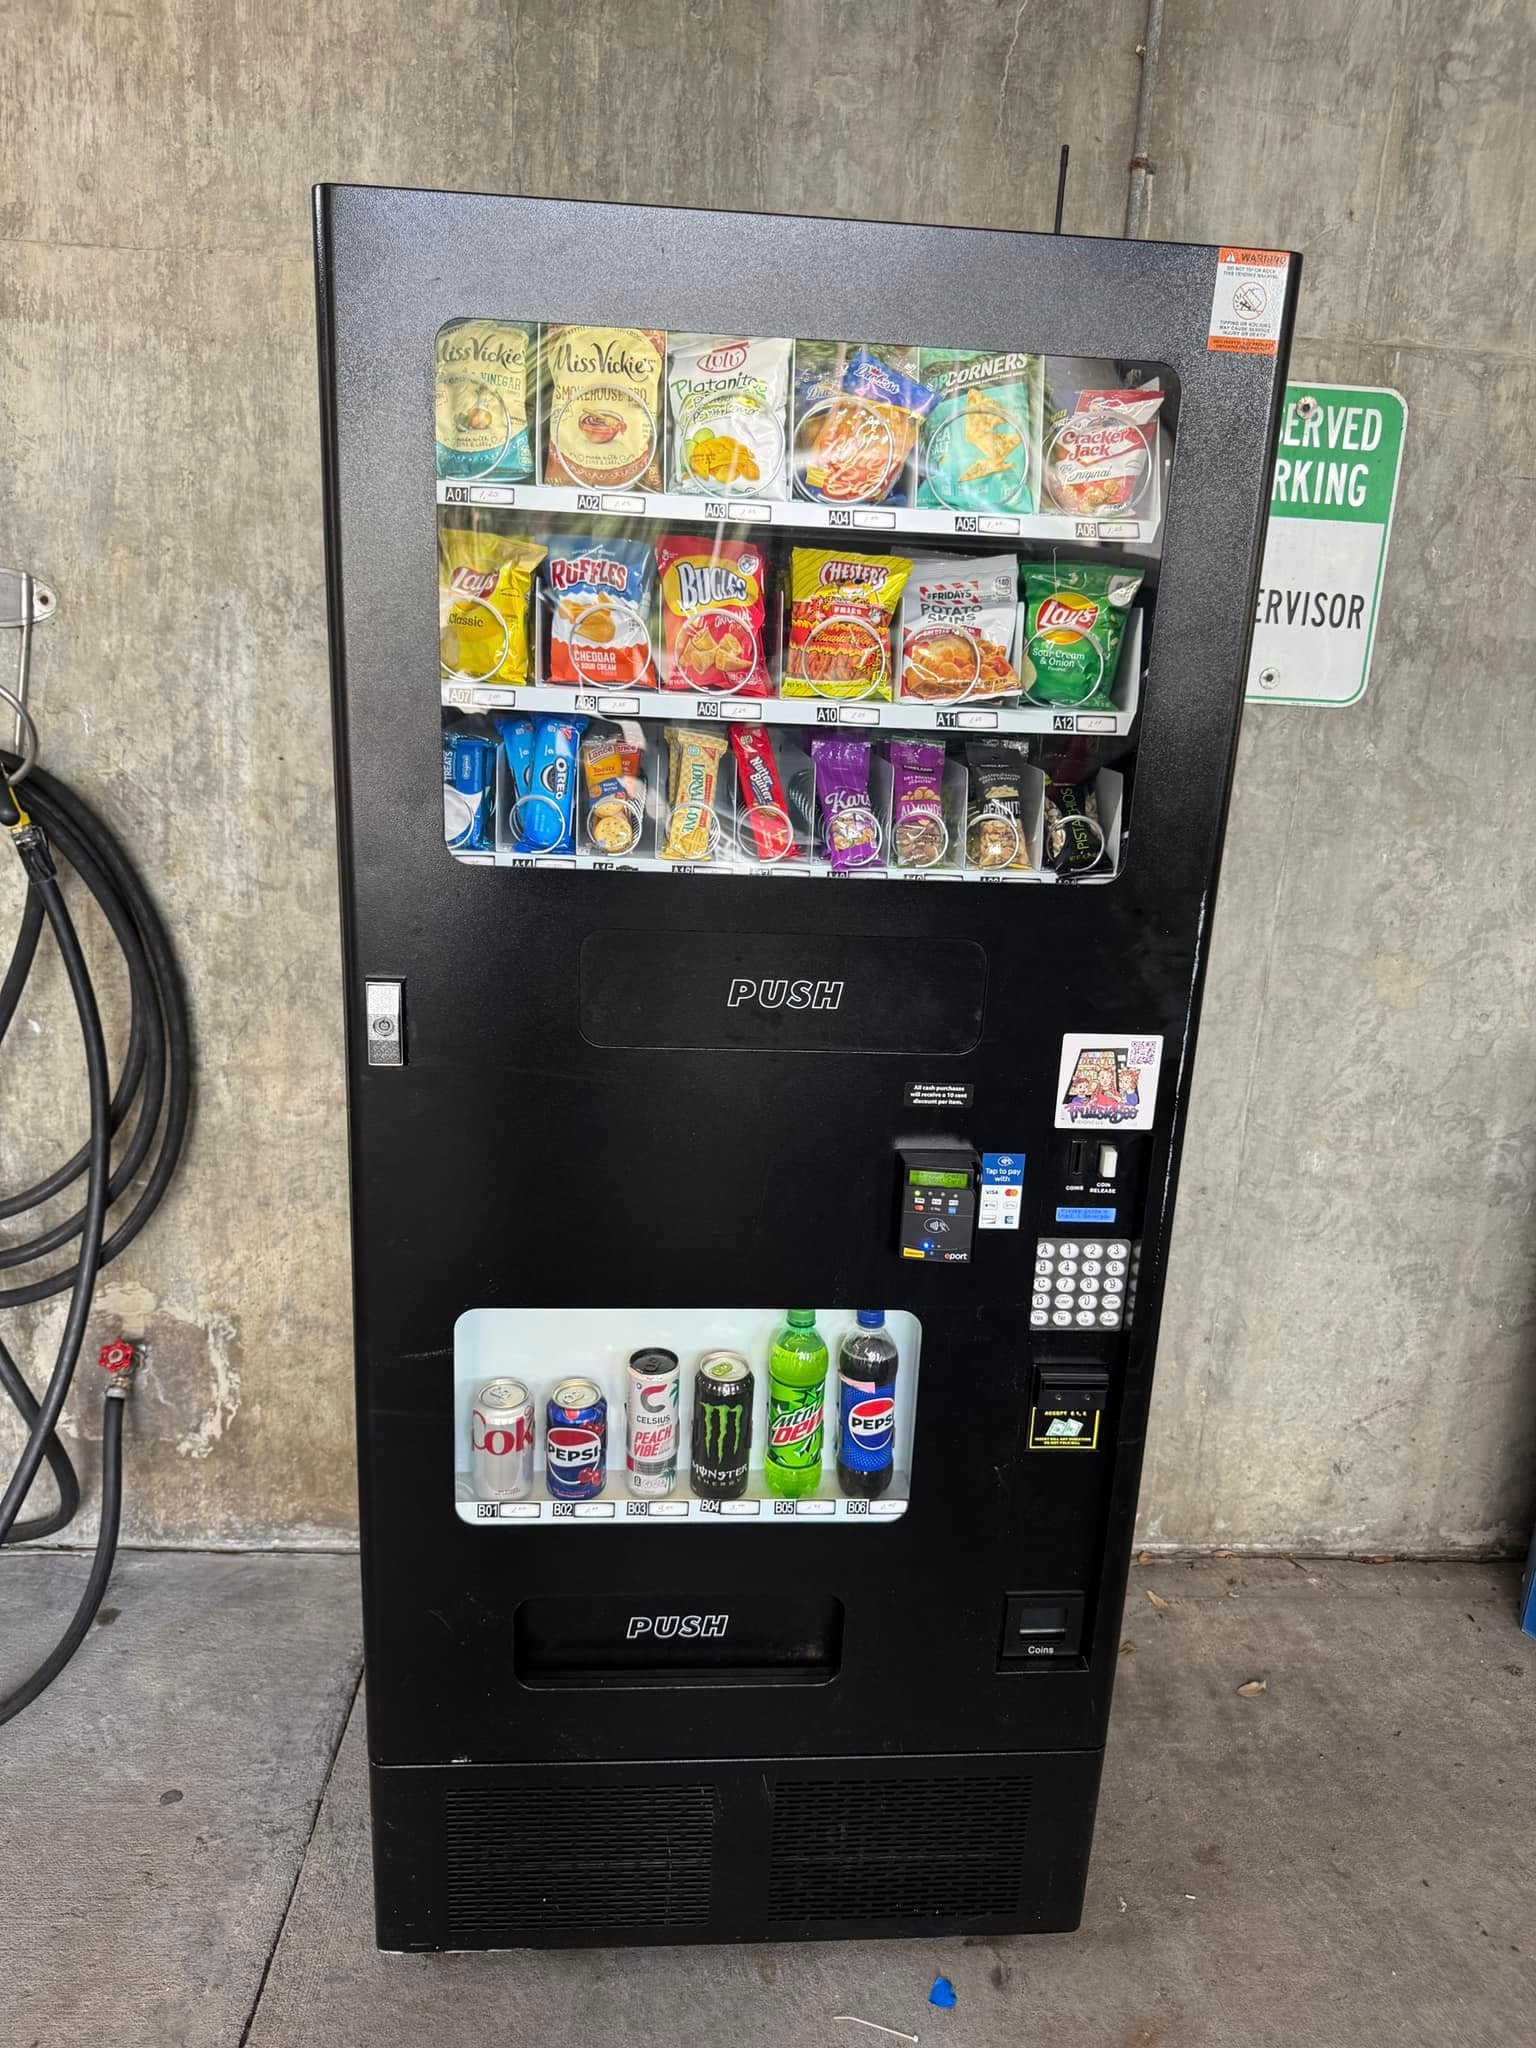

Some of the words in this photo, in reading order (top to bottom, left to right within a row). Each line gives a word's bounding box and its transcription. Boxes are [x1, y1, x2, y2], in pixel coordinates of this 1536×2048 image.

[552, 343, 597, 375] Miss
[591, 340, 655, 383] Vickie's
[480, 371, 521, 389] VINEGAR
[854, 362, 901, 395] Duchess
[555, 385, 625, 402] SMOEHOUSE
[1061, 428, 1130, 446] Cracker
[1068, 444, 1112, 461] Jack
[1066, 465, 1113, 482] Original
[447, 487, 468, 501] A01
[578, 496, 599, 510] A02
[706, 504, 726, 518] A03
[830, 511, 850, 525] A04
[956, 517, 976, 531] A05
[1077, 524, 1096, 537] A06
[551, 558, 628, 592] RUFFLES
[820, 561, 889, 590] CHESTER'S
[676, 562, 748, 609] BUGLES
[833, 607, 862, 615] FRIES
[920, 603, 983, 616] POTATO
[448, 613, 484, 628] Classic
[928, 613, 976, 624] SKINS
[573, 651, 617, 664] CHEDDAR
[1032, 647, 1054, 657] Sour
[1055, 649, 1086, 660] Cream
[1048, 656, 1075, 667] Onion
[448, 688, 471, 702] A07
[576, 696, 596, 710] A08
[698, 702, 718, 716] A09
[818, 708, 838, 722] A10
[937, 713, 957, 727] A11
[1054, 716, 1074, 730] A12
[588, 745, 614, 761] Lance
[443, 750, 454, 781] TREATS
[749, 755, 774, 787] Nutter
[555, 756, 568, 800] OREO
[688, 762, 706, 797] LORNA
[749, 773, 773, 802] Butter
[1061, 787, 1089, 851] PISTACHIOS
[727, 979, 845, 1009] PUSH
[936, 1085, 965, 1094] purchases
[986, 1168, 998, 1176] Tap
[1007, 1169, 1022, 1177] pay
[994, 1175, 1010, 1183] with
[944, 1252, 968, 1261] eport
[636, 1413, 671, 1425] CELSIUS
[634, 1425, 673, 1444] PEACH
[633, 1443, 660, 1457] VIBE
[691, 1461, 748, 1481] MONSTER
[479, 1504, 498, 1517] B01
[554, 1503, 573, 1516] B02
[628, 1502, 647, 1515] B03
[701, 1500, 719, 1513] B04
[775, 1502, 794, 1514] B05
[848, 1502, 866, 1514] B06
[626, 1615, 729, 1639] PUSH
[1027, 1645, 1055, 1655] Coins
